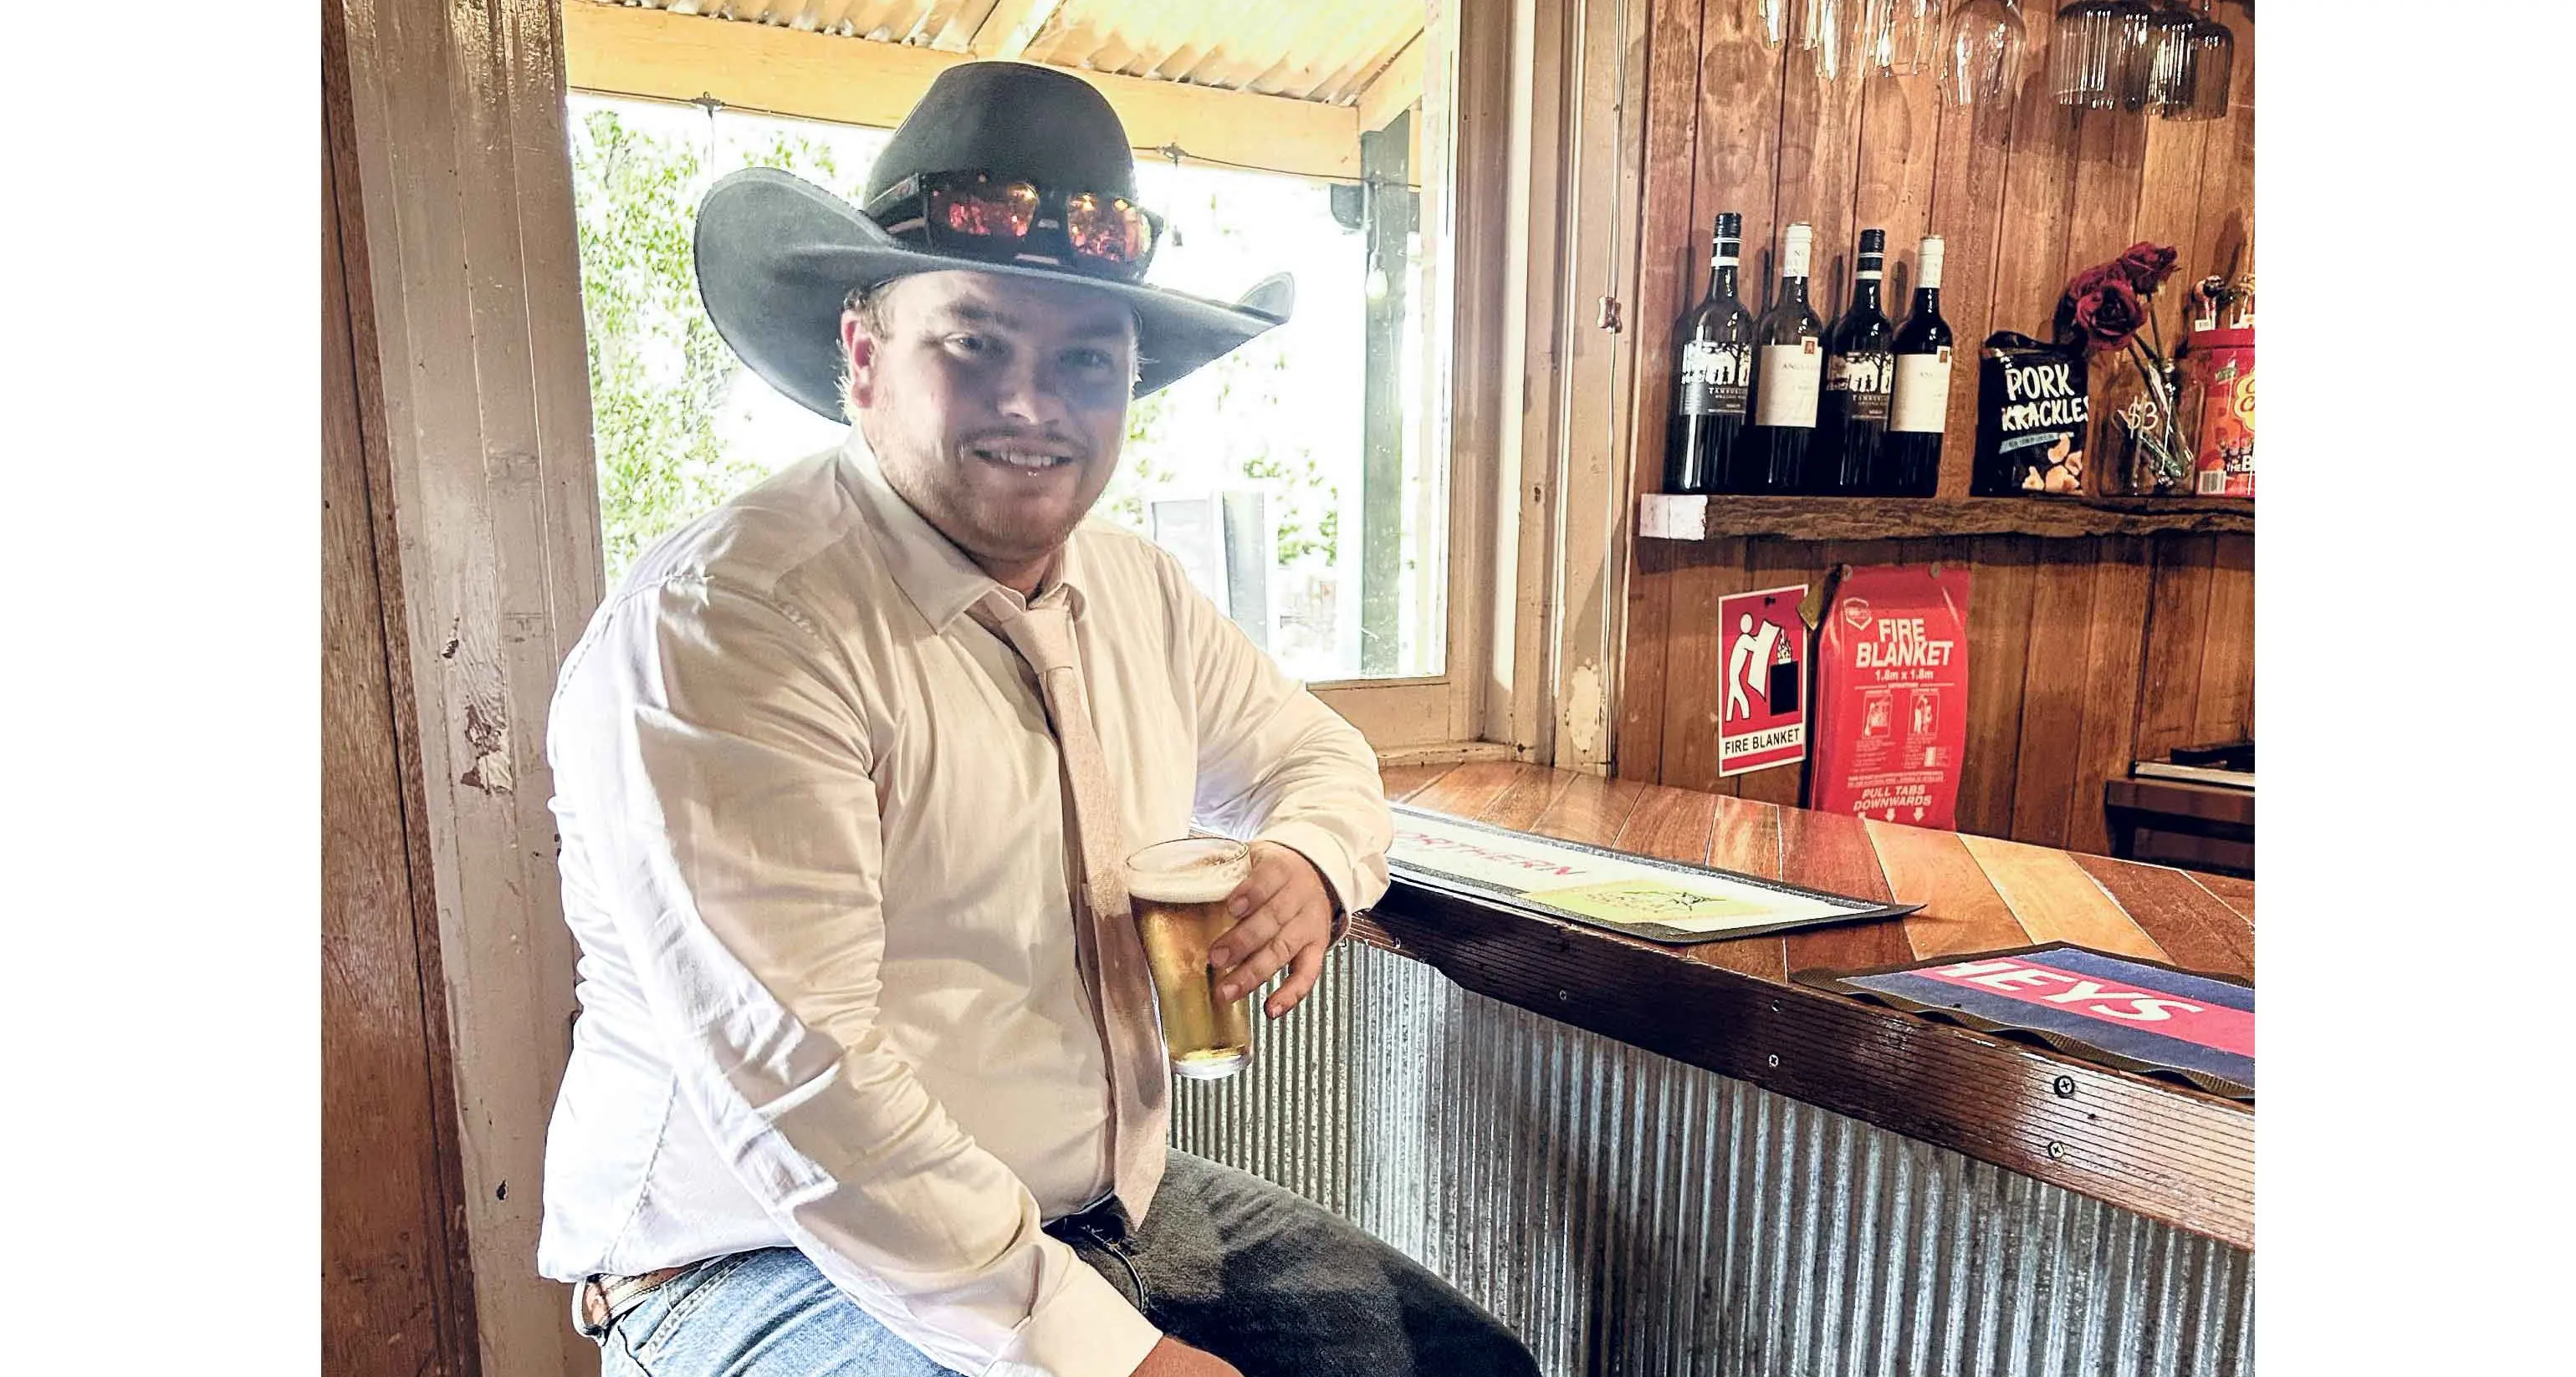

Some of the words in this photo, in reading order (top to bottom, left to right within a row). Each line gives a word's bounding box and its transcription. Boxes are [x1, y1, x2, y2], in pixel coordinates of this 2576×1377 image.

[2005, 364, 2075, 401] PORK
[2128, 395, 2159, 440] $3
[1878, 618, 1926, 643] FIRE
[1855, 640, 1954, 668] BLANKET
[1874, 670, 1899, 681] 1.8m
[1910, 668, 1934, 681] 1.8m
[1725, 738, 1749, 755] FIRE
[1752, 727, 1800, 750] BLANKET
[1853, 795, 1933, 812] DOWNWARDS
[1862, 786, 1891, 800] PULL
[1894, 784, 1925, 796] TABS
